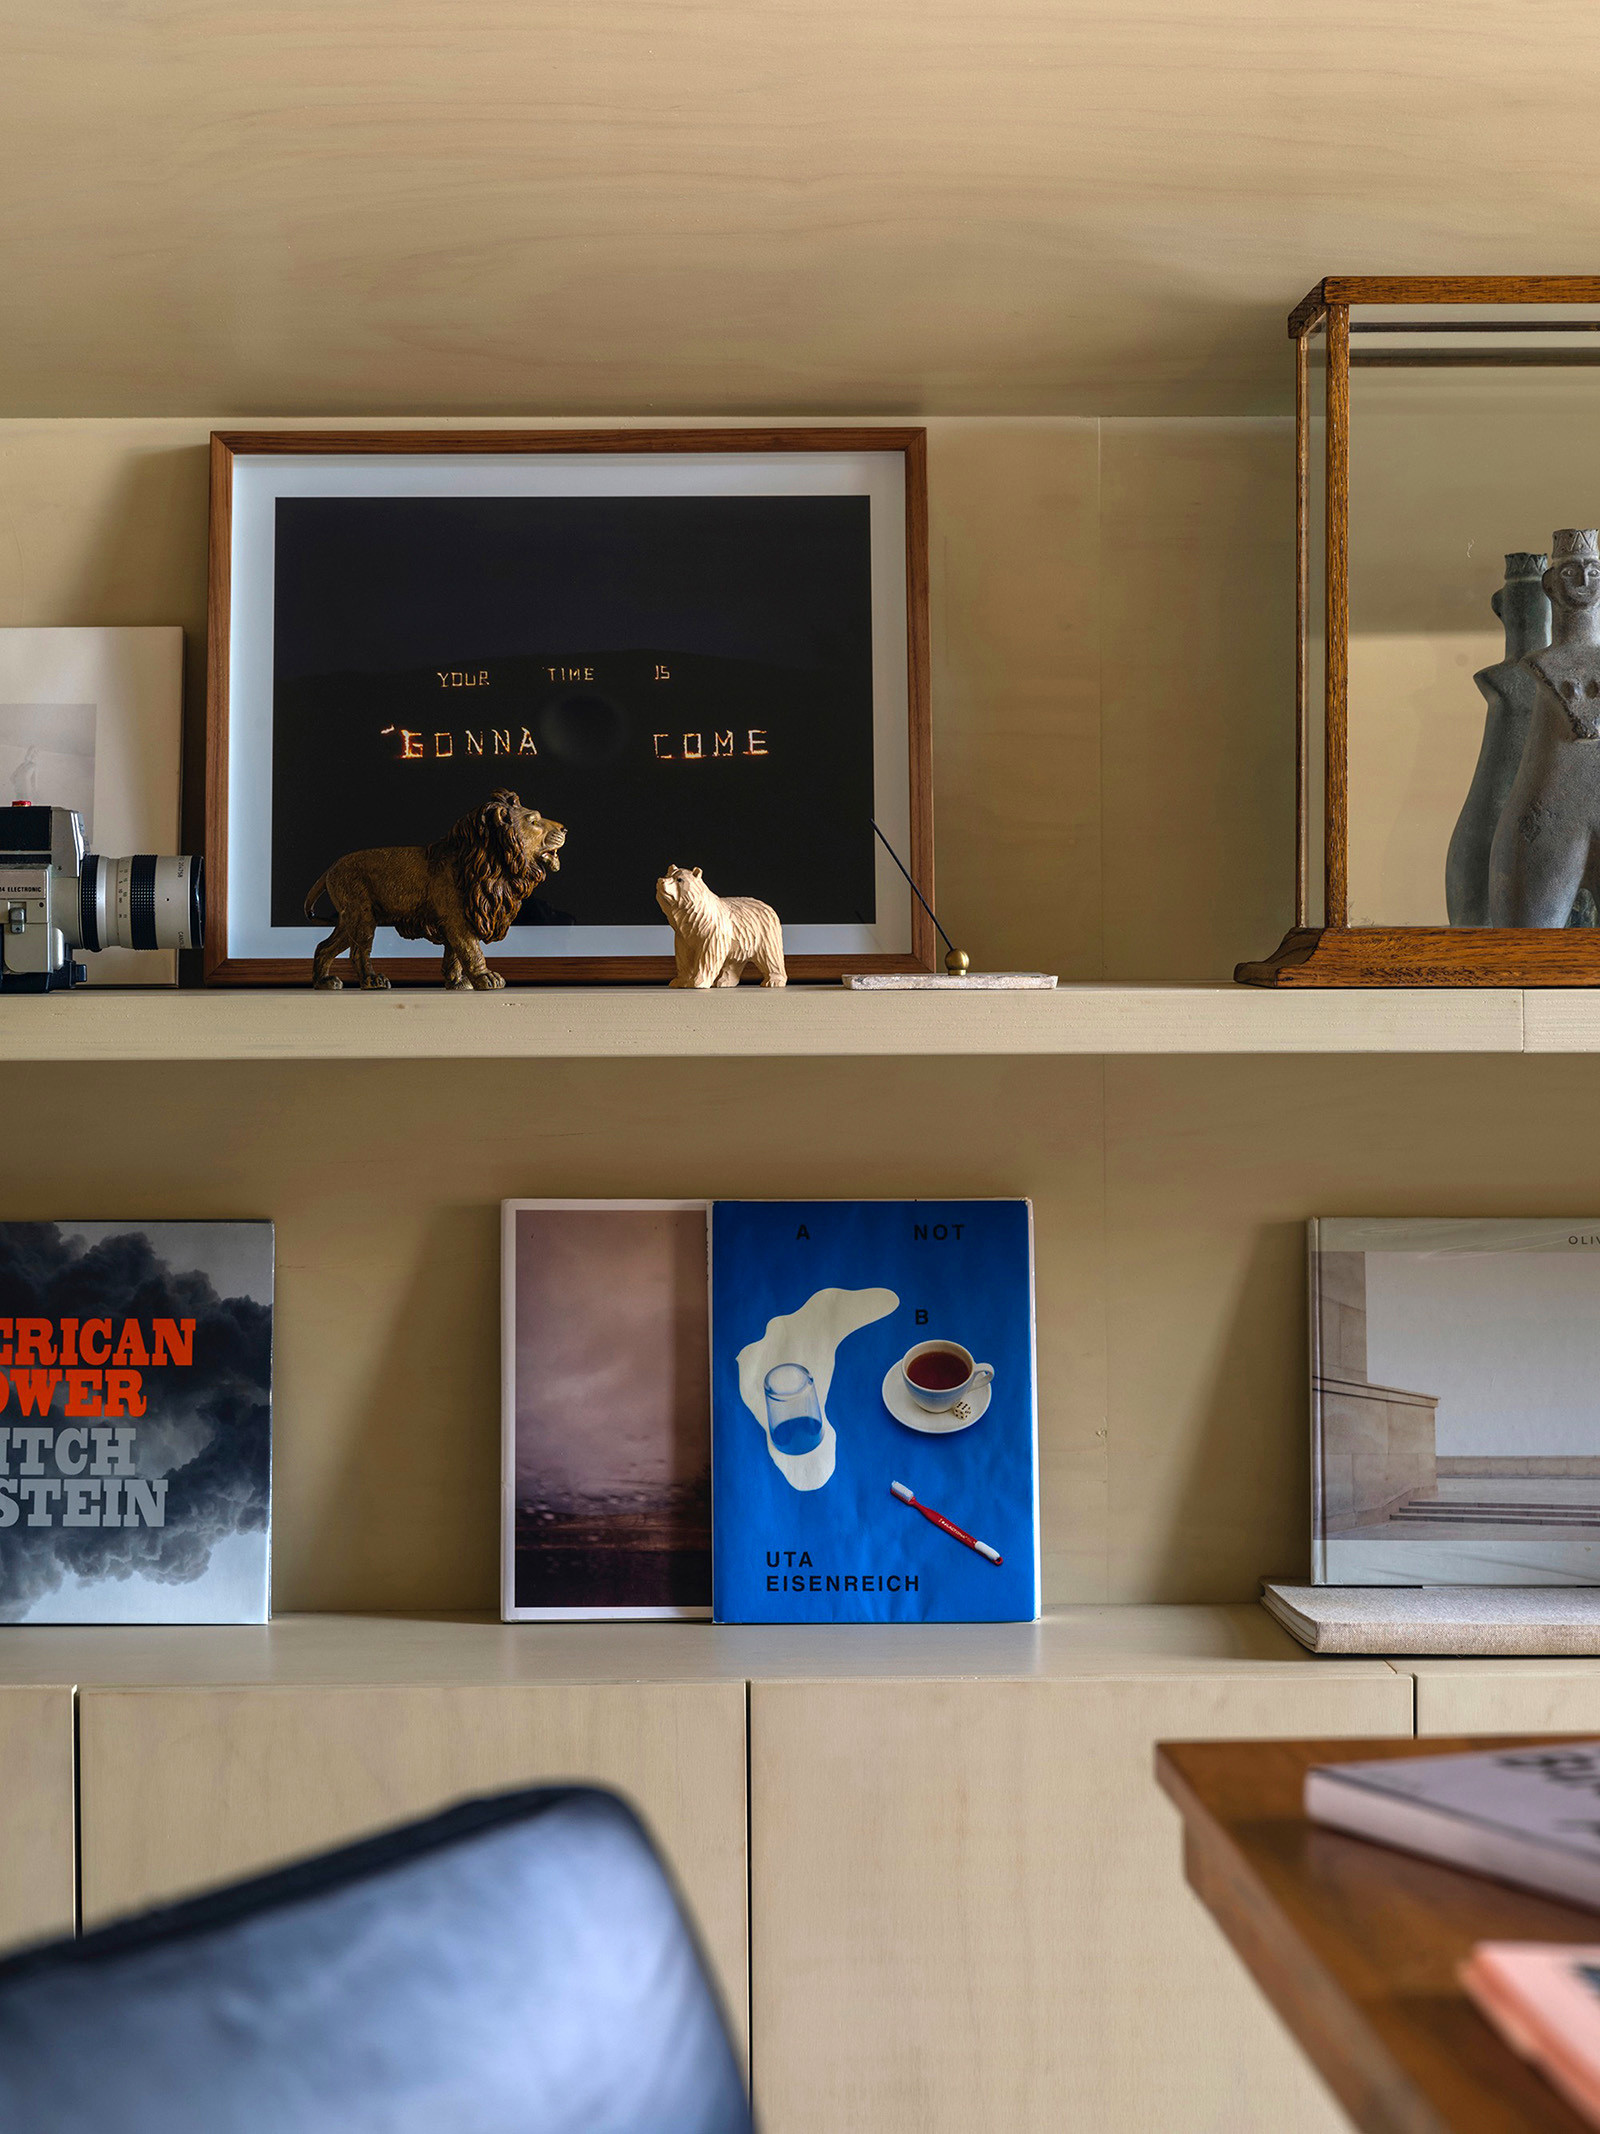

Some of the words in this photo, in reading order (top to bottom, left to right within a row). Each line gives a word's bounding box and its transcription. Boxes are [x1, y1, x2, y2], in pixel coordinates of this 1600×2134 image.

[437, 670, 490, 687] YOUR
[548, 667, 594, 682] TIME
[654, 664, 670, 680] IS
[401, 727, 538, 758] GONNA
[653, 730, 769, 758] COME
[796, 1224, 811, 1241] A
[913, 1223, 966, 1242] NOT
[914, 1308, 930, 1326] B
[0, 1369, 147, 1417] WER
[765, 1551, 813, 1568] UTA
[765, 1575, 920, 1592] EISENREICH
